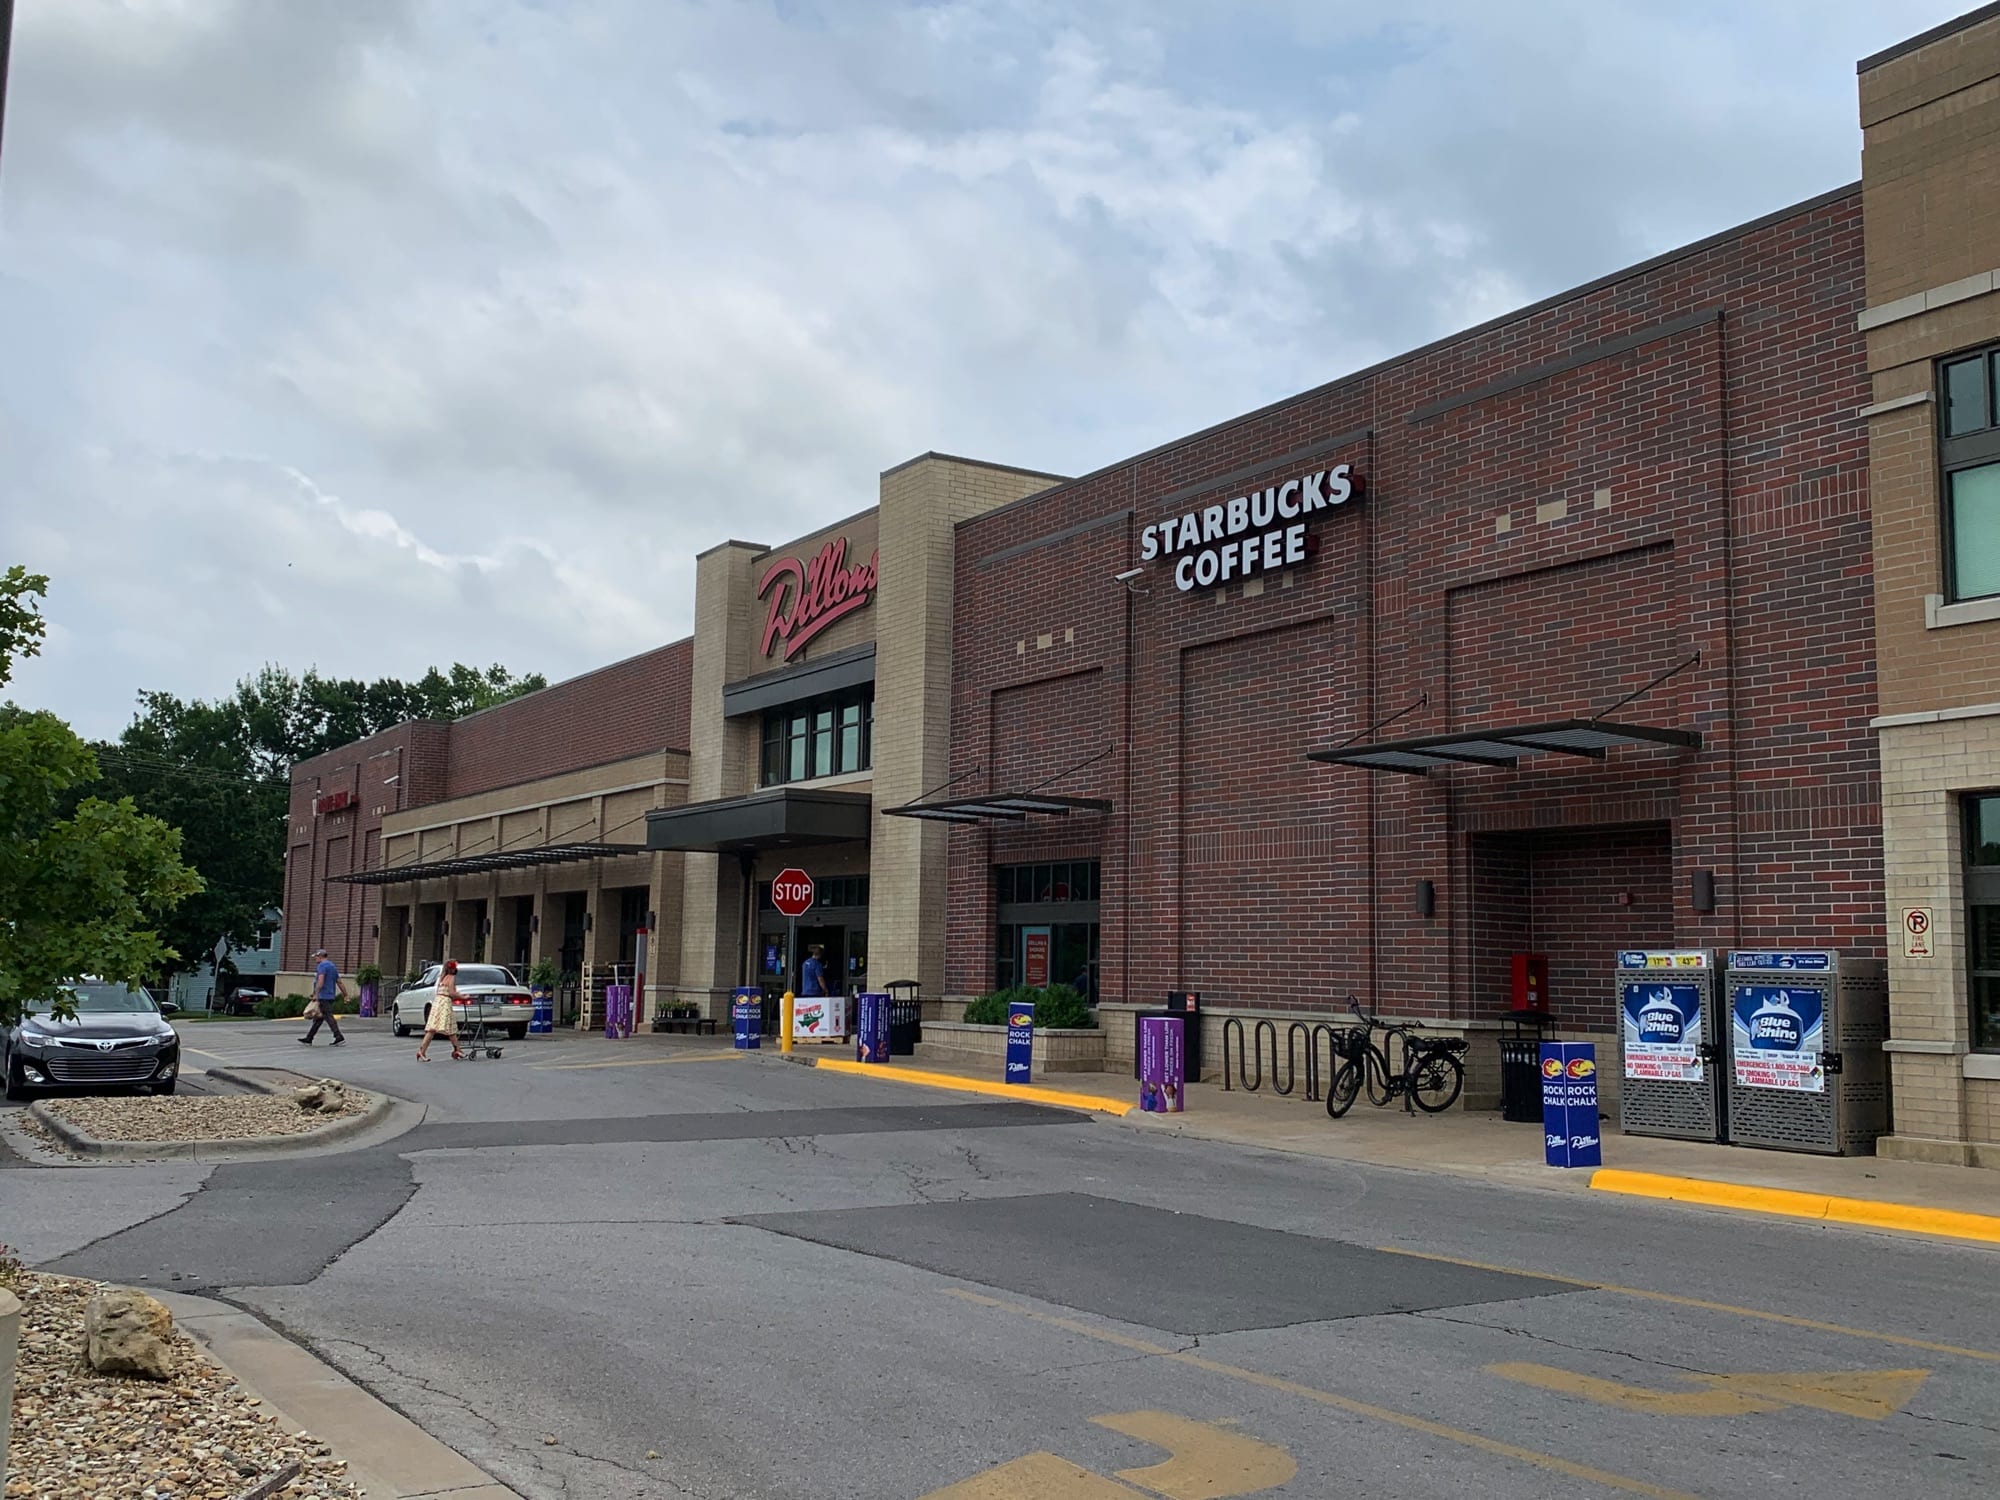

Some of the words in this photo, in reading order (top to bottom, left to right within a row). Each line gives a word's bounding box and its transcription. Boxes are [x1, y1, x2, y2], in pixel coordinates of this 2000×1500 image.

[1141, 464, 1351, 560] STARBUCKS
[1175, 523, 1306, 592] COFFEE
[758, 536, 879, 656] Dillons
[775, 883, 811, 901] STOP
[1647, 1011, 1673, 1022] Blue
[1760, 1016, 1791, 1027] Blue
[1008, 1038, 1031, 1046] CHALK
[1633, 1069, 1663, 1077] FLAMMABLE
[1745, 1077, 1778, 1086] FLAMMABLE
[1779, 1079, 1786, 1087] LP
[1543, 1085, 1564, 1095] ROCK
[1567, 1085, 1596, 1096] ROCK
[1543, 1096, 1565, 1106] CHALK
[1567, 1097, 1597, 1106] CHALK
